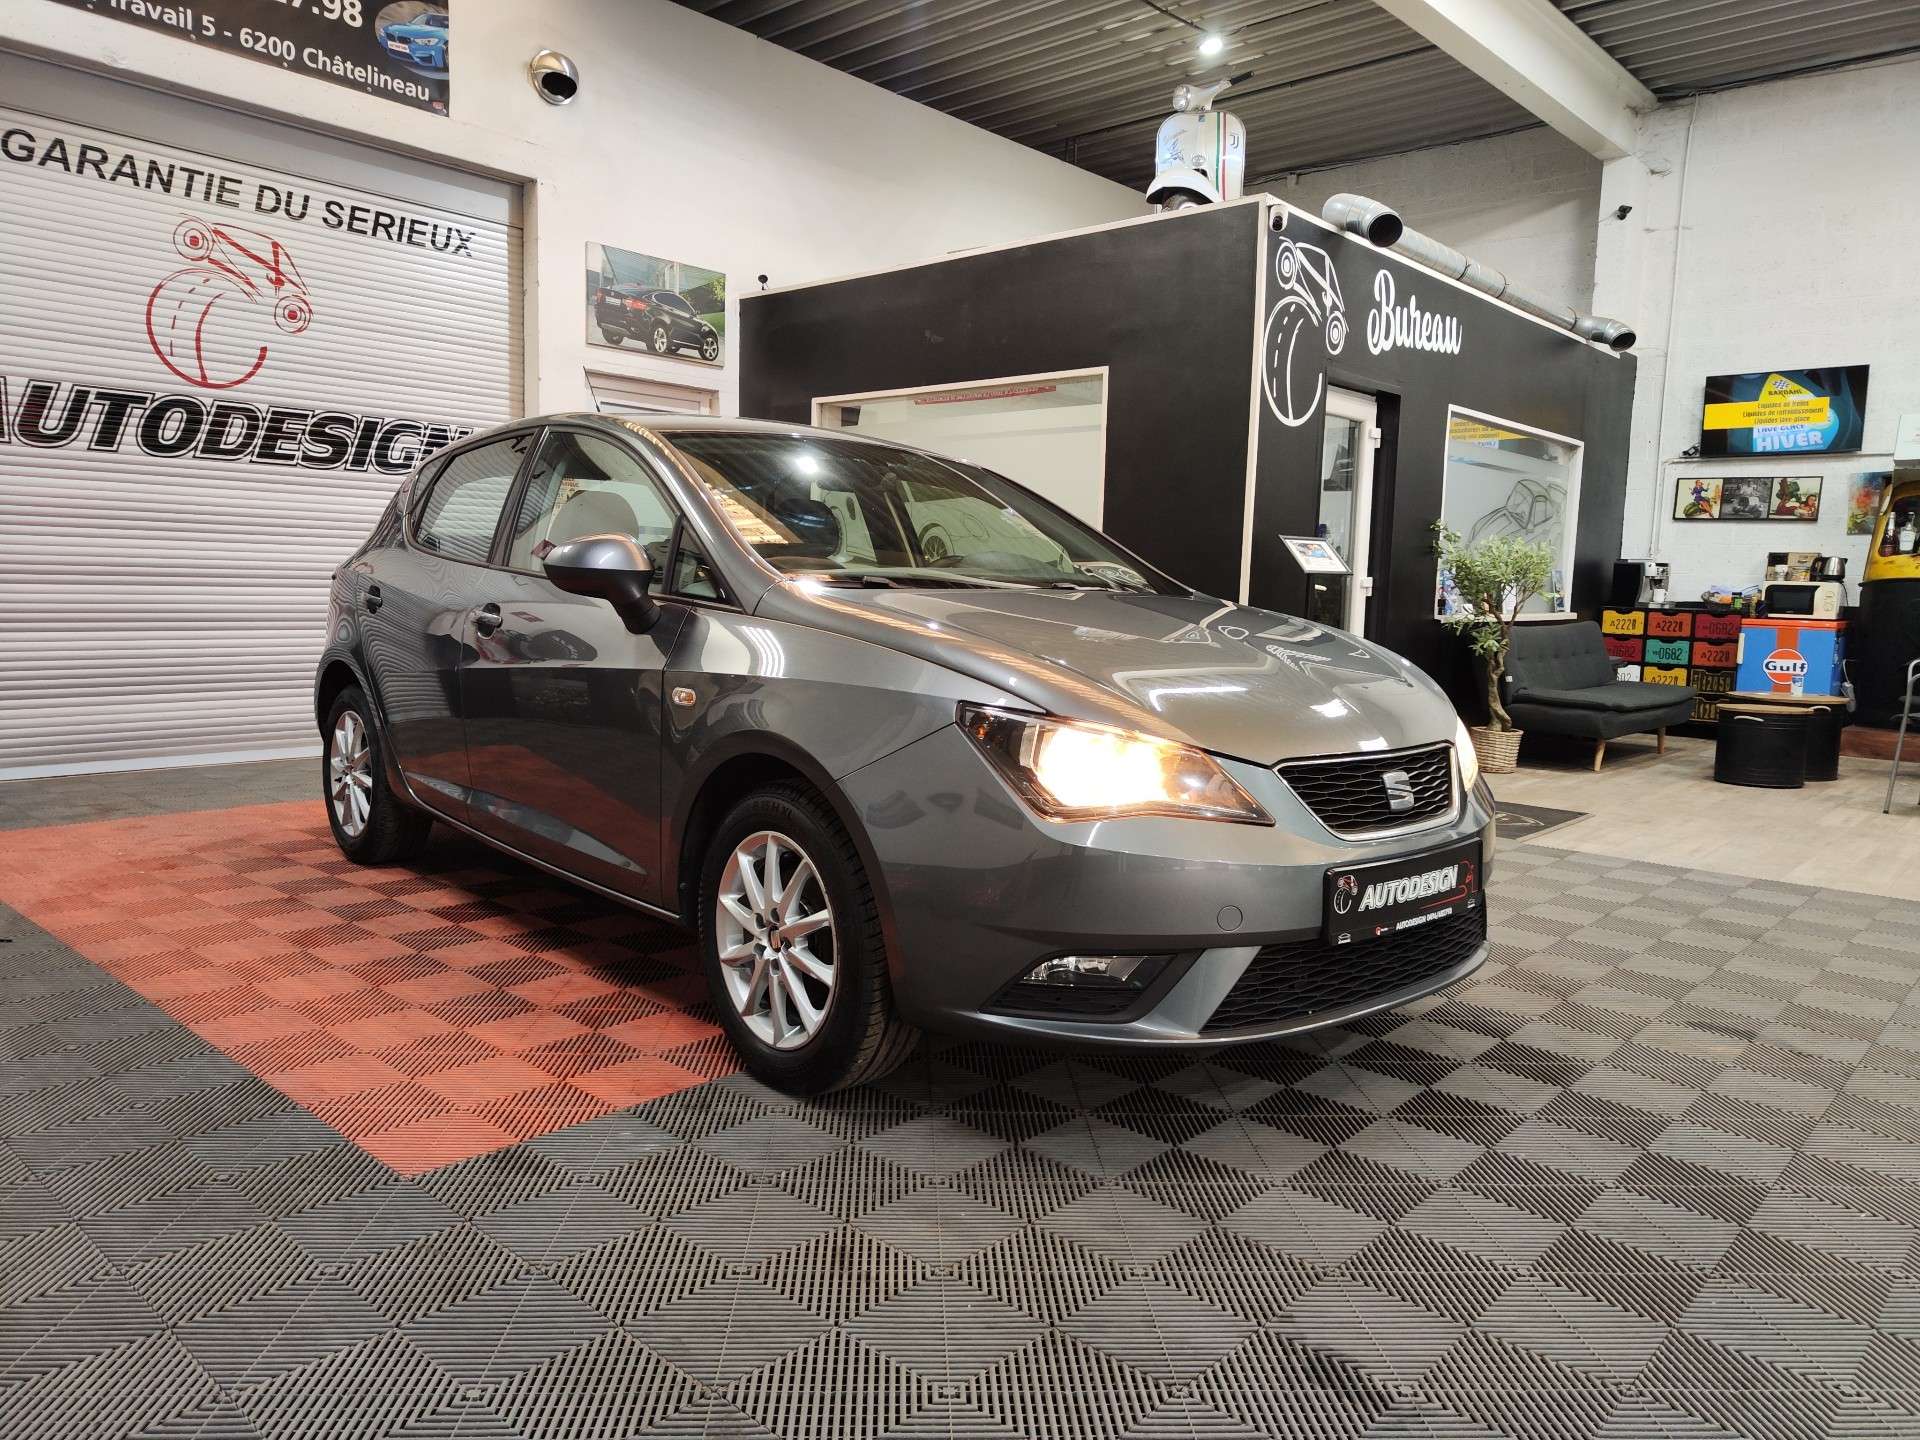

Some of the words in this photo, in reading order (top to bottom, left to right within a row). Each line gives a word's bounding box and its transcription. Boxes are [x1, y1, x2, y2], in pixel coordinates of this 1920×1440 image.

[275, 0, 363, 28] .98
[201, 15, 216, 37] 5
[239, 27, 296, 61] 6200
[302, 47, 430, 101] Châtelineau
[2, 129, 243, 209] GARANTIE
[255, 184, 309, 221] DU
[322, 201, 477, 258] SERIEUX
[1366, 269, 1463, 356] Bureau
[1756, 431, 1824, 452] HIVER
[1765, 661, 1807, 672] Gulf
[1358, 864, 1459, 912] AUTODESIGN
